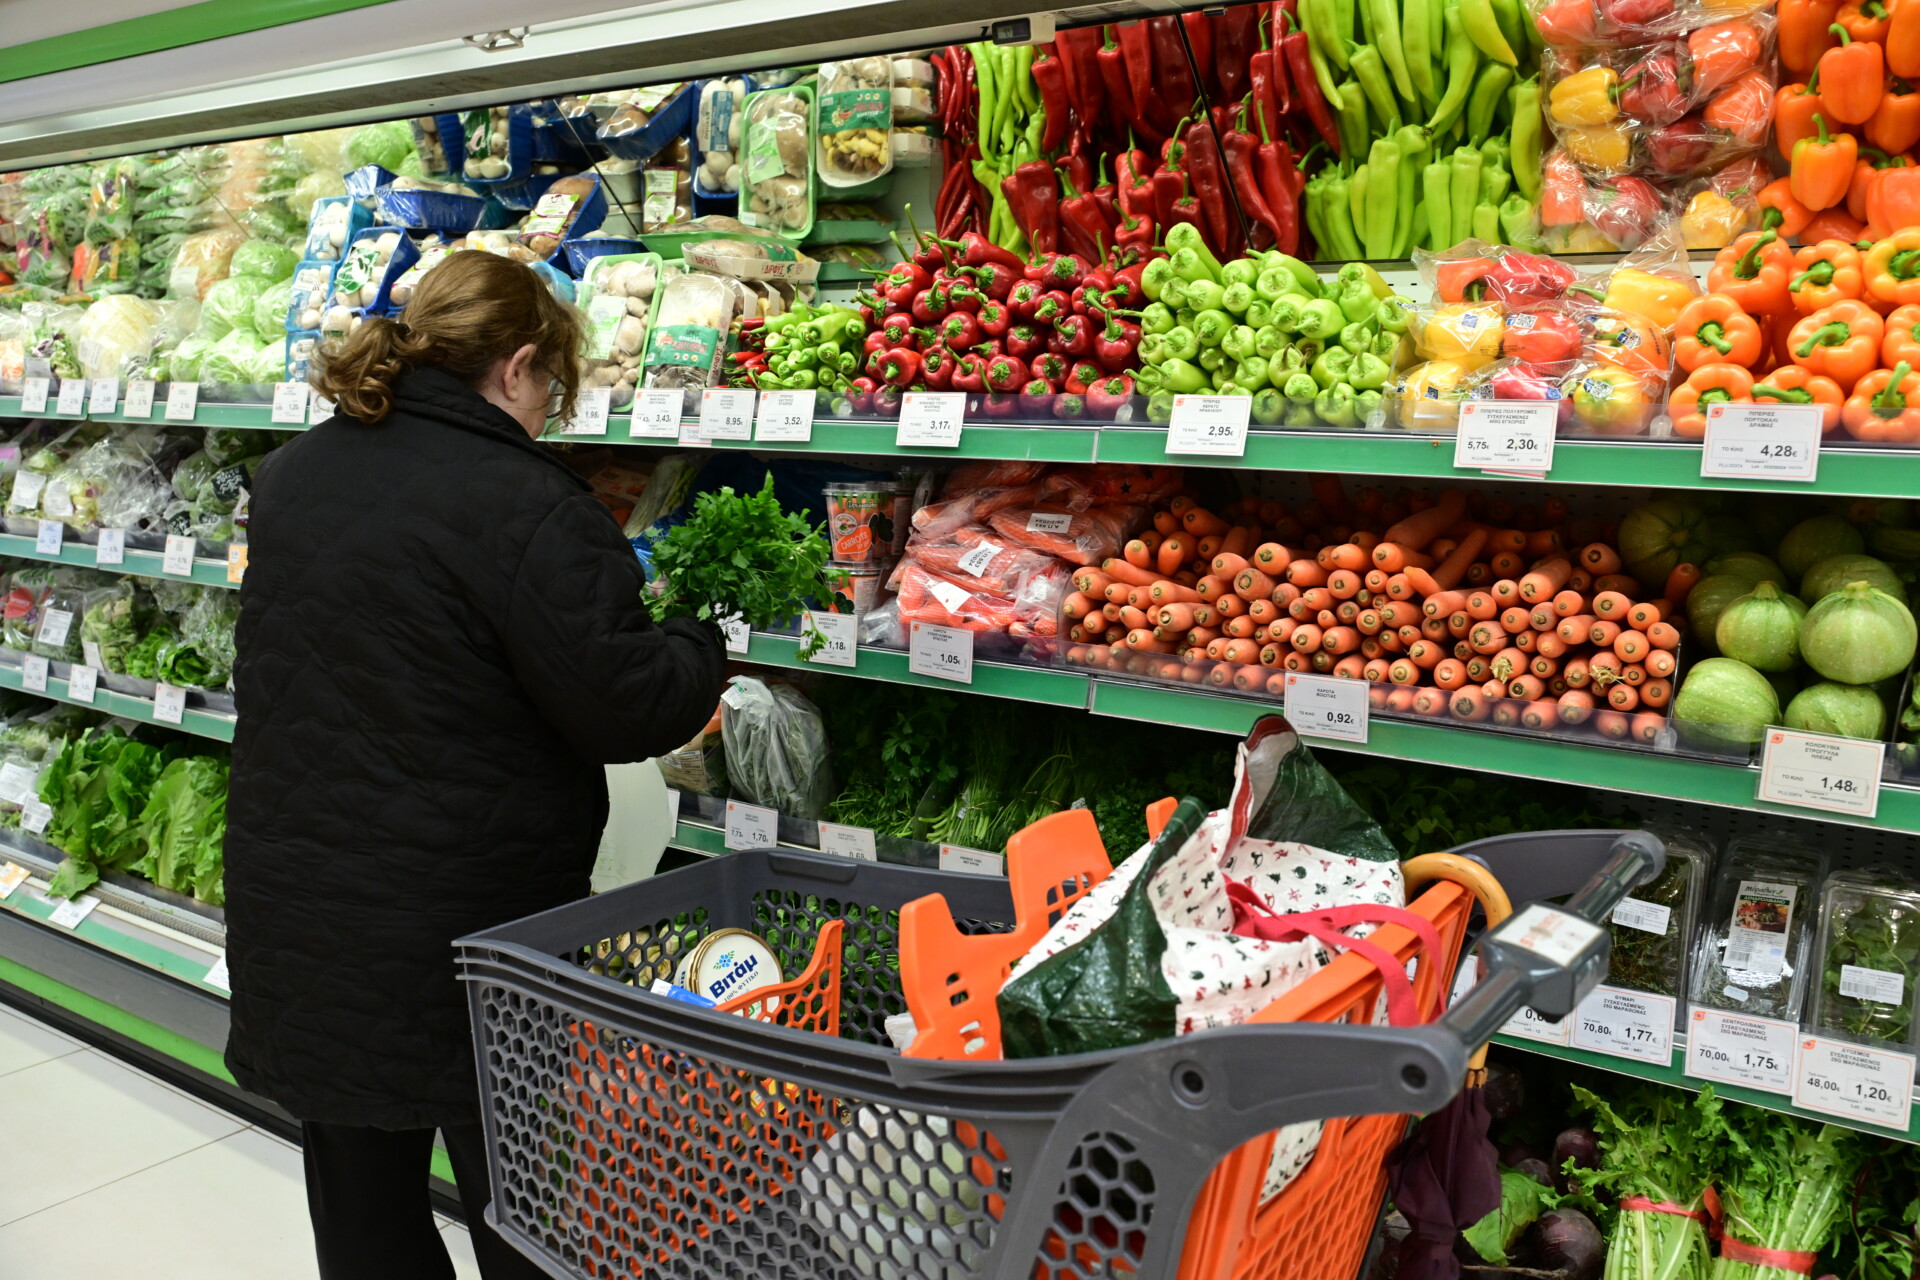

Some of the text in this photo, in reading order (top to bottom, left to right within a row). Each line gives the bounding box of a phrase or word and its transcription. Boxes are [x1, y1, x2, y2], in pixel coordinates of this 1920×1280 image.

[725, 417, 744, 428] 8,95€
[784, 417, 802, 427] 3,52€
[930, 420, 951, 431] 3,17€
[1208, 426, 1234, 437] 2,95€
[1467, 438, 1538, 452] 5,75€ 2,30€
[1760, 445, 1798, 460] 4,28€
[828, 640, 846, 651] 1,18€
[940, 652, 961, 666] 1,05€
[1326, 711, 1354, 725] 0,92€
[1804, 748, 1840, 757] ΣΤΡΟΓΓΥΛΑ
[1805, 742, 1840, 751] ΚΟΛΟΚΥΘΙΑ
[1820, 776, 1858, 794] 1,48€
[709, 954, 758, 999] Βιτάμ
[737, 970, 759, 991] ΦΥΤΙΚΟ
[1604, 998, 1646, 1011] ΣΥΣΚΕΥΑΣΜΕΝΟ
[1614, 995, 1635, 1003] ΘΥΜΑΡΙ
[1721, 1024, 1766, 1036] ΣΥΣΚΕΥΑΣΜΕΝΟ
[1722, 1018, 1766, 1030] ΔΕΝΤΡΟΛΙΒΑΝΟ
[1583, 1022, 1657, 1045] 70,80€ 1,77€
[1731, 1030, 1768, 1042] ΜΑΡΑΘΩΝΑΣ
[1830, 1051, 1881, 1067] ΣΥΣΚΕΥΑΣΜΕΝΟΣ
[1841, 1047, 1870, 1058] ΔΥΟΣΜΟΣ
[1698, 1048, 1779, 1071] 70,00€ 1,75€
[1842, 1058, 1881, 1072] ΜΑΡΑΘΩΝΑΣ
[1807, 1077, 1893, 1104] 48,00€ 1,20€
